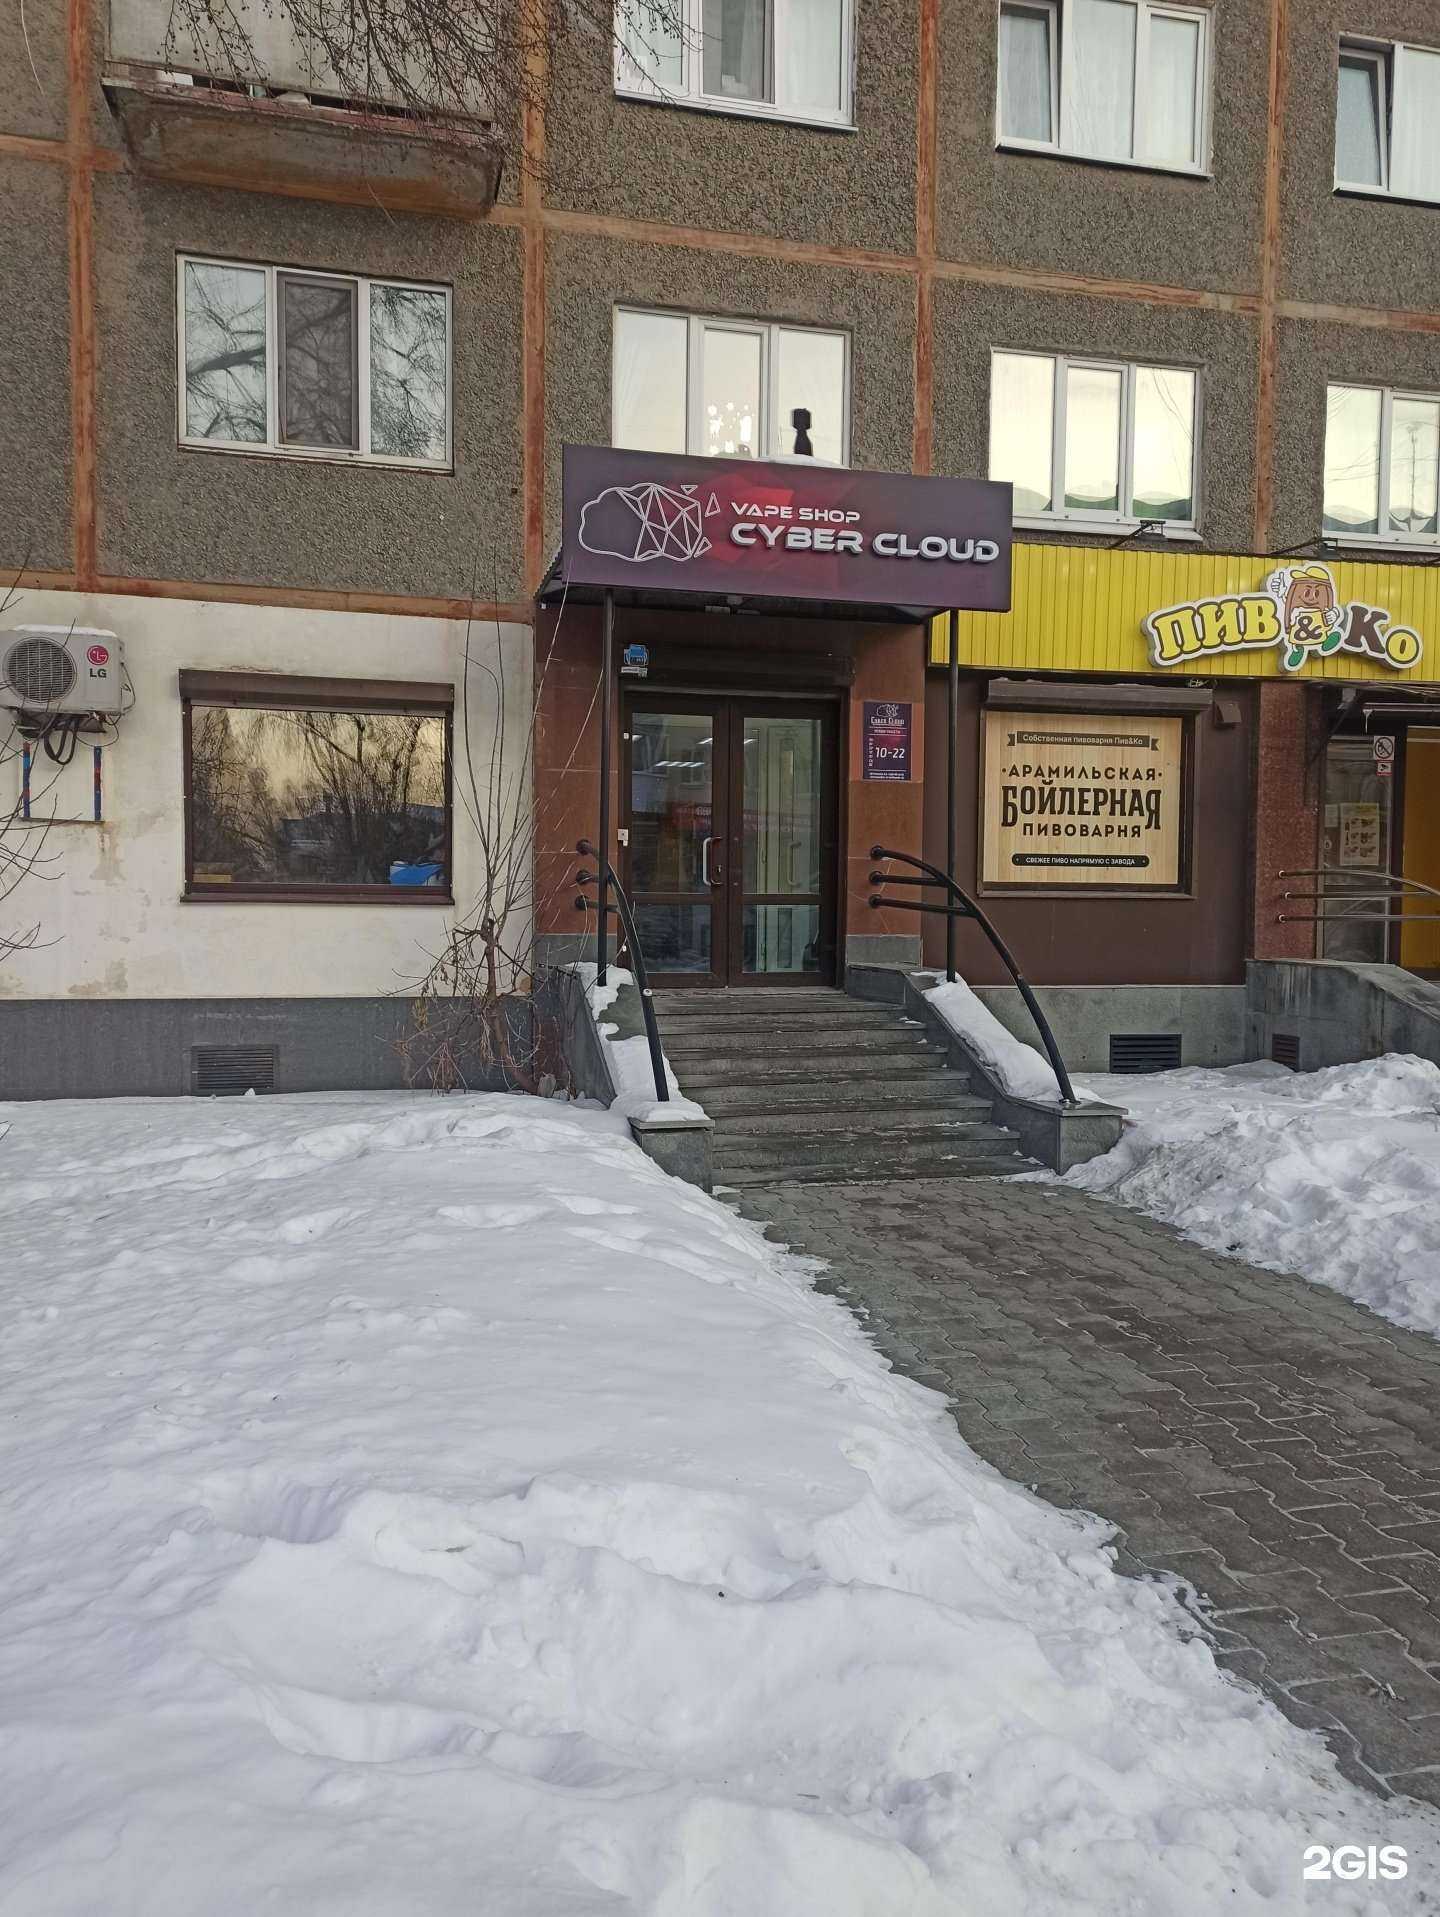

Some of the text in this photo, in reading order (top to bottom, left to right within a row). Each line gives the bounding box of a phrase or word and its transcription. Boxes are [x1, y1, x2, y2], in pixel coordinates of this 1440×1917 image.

[731, 502, 861, 524] VAPE SHOP
[730, 522, 1001, 563] CYBER CLOUD
[89, 668, 107, 678] LG
[1022, 733, 1143, 745] Собственная пивоварня Пив&Ко
[875, 747, 905, 759] 10-22
[1008, 763, 1156, 781] АРАМИЛЬСКАЯ
[1001, 779, 1162, 830] БОЙЛЕРНАЯ
[1022, 822, 1142, 838] ПИВОВАРНЯ
